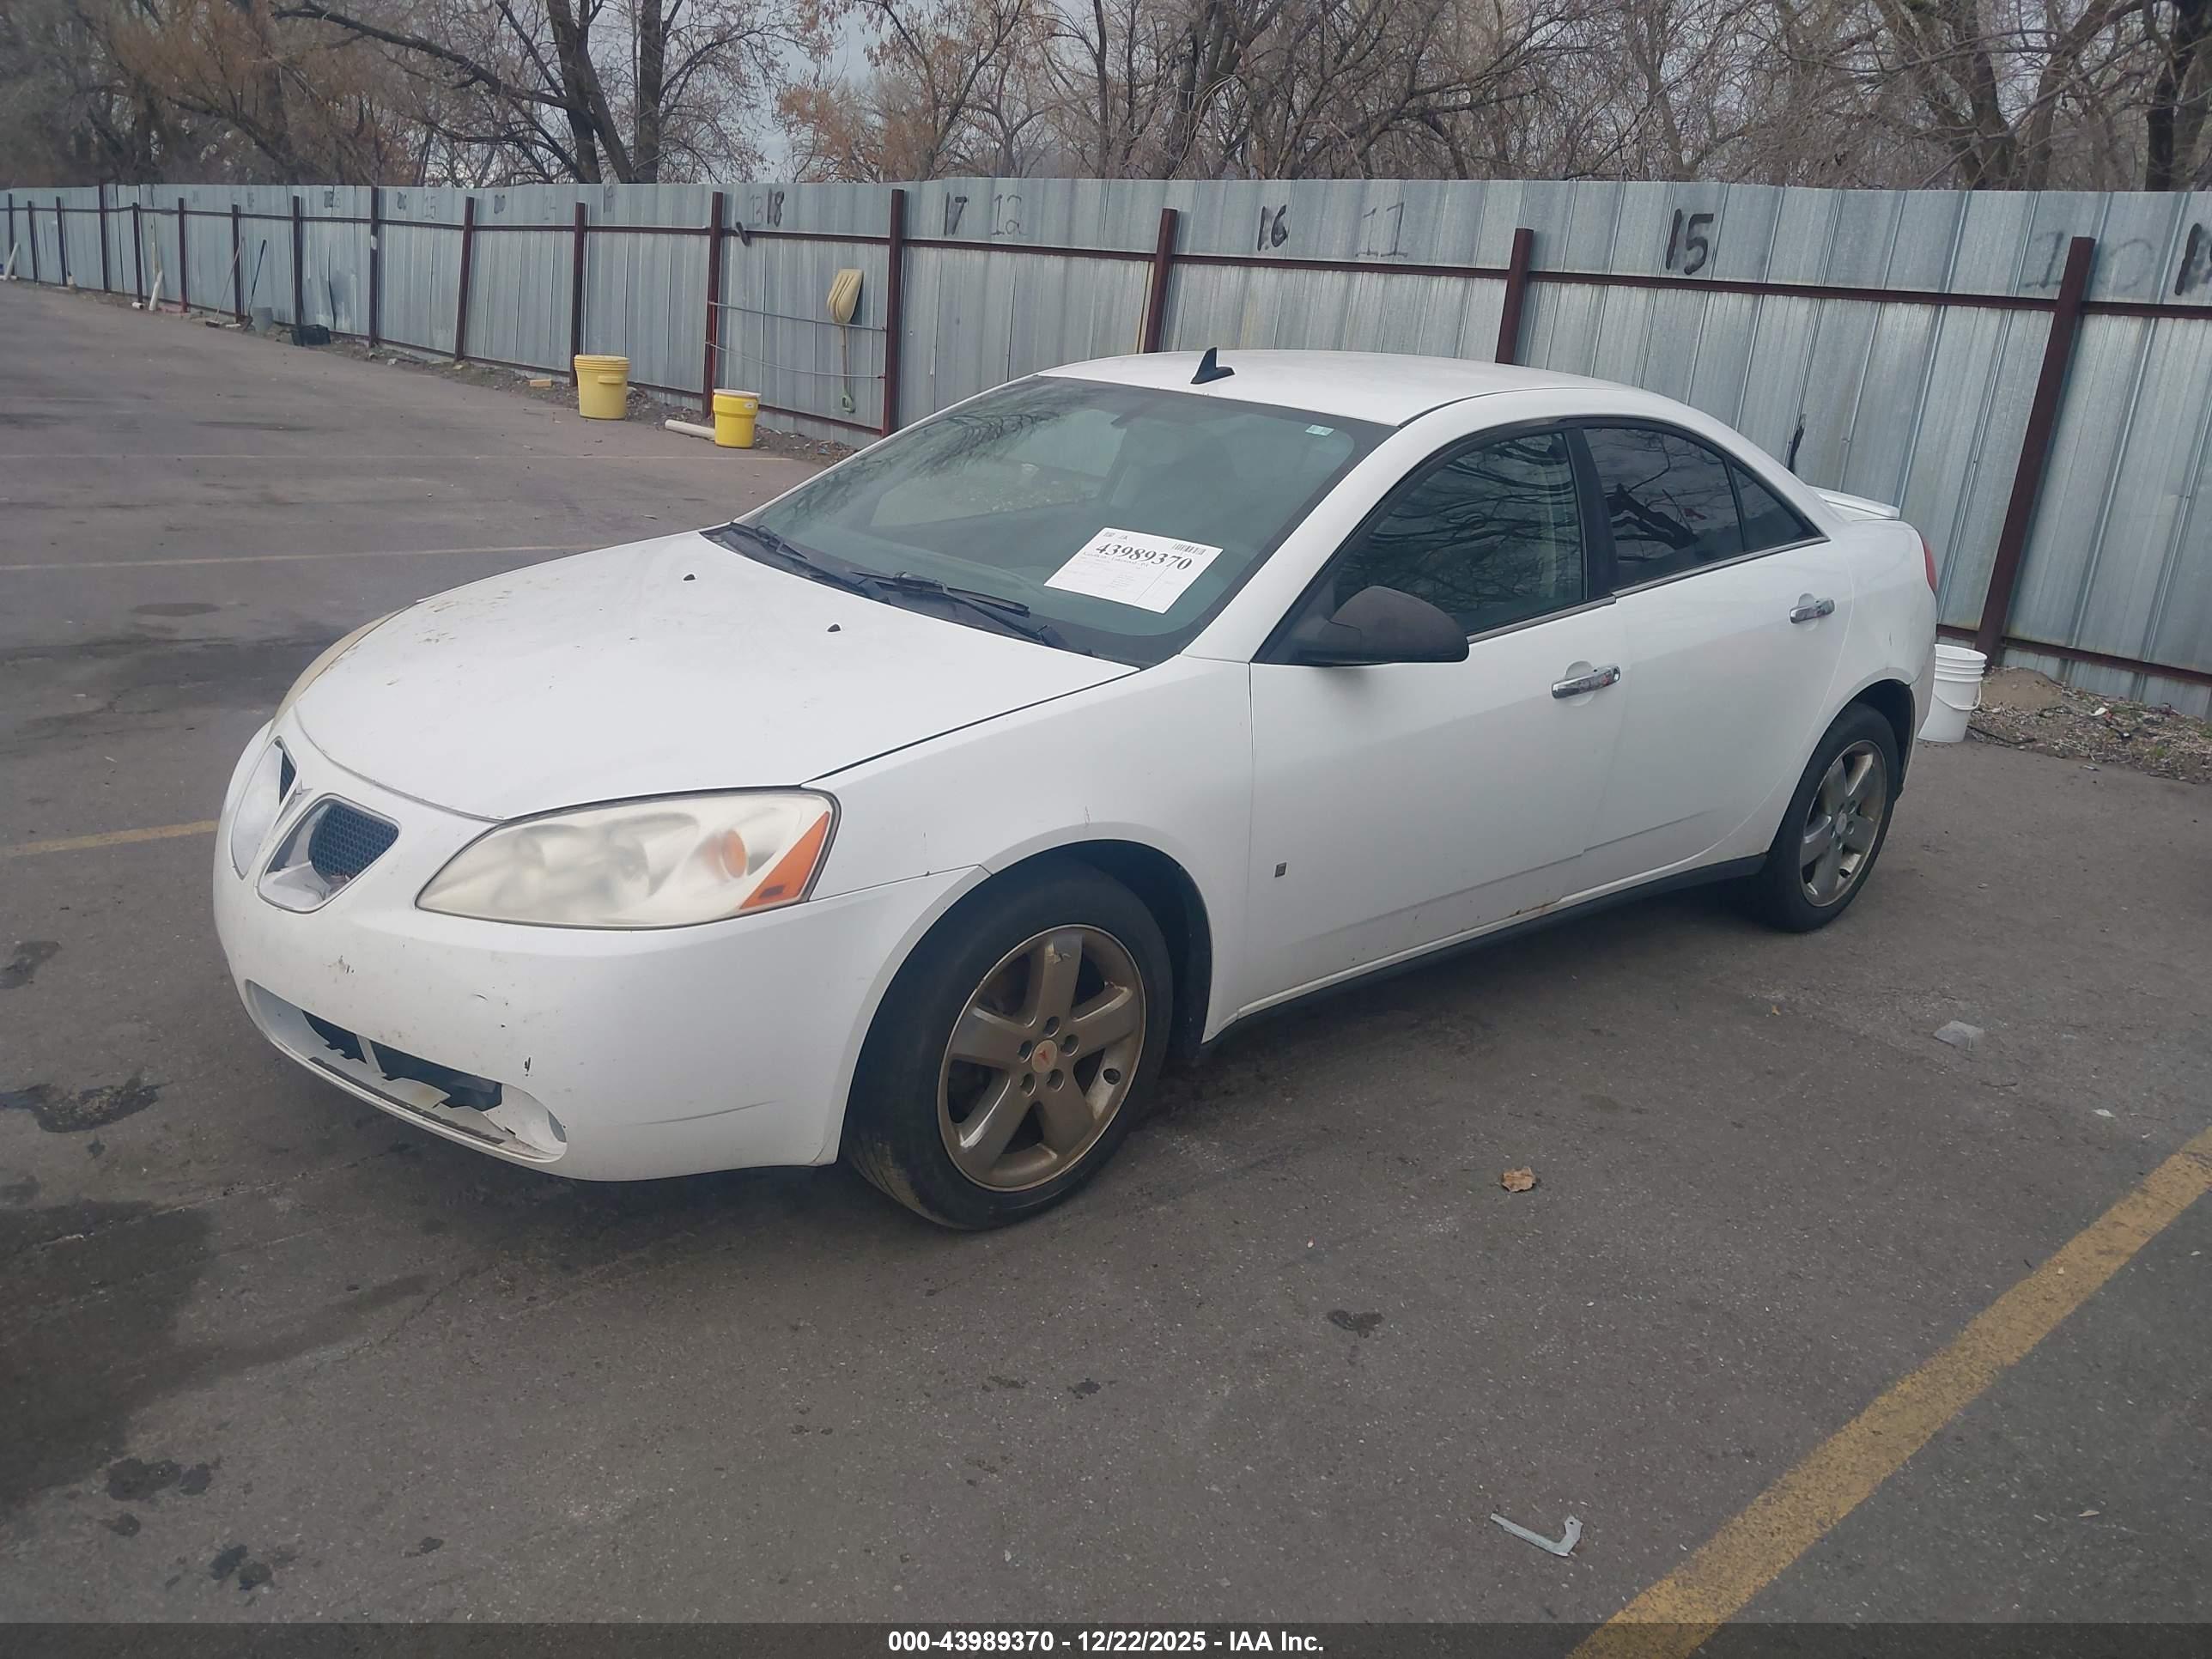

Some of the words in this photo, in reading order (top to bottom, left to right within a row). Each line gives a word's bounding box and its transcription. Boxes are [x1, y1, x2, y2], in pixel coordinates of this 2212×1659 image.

[944, 191, 968, 236] 17
[1257, 204, 1288, 252] 16
[1665, 208, 1714, 276] 15
[1095, 542, 1194, 571] 43989370
